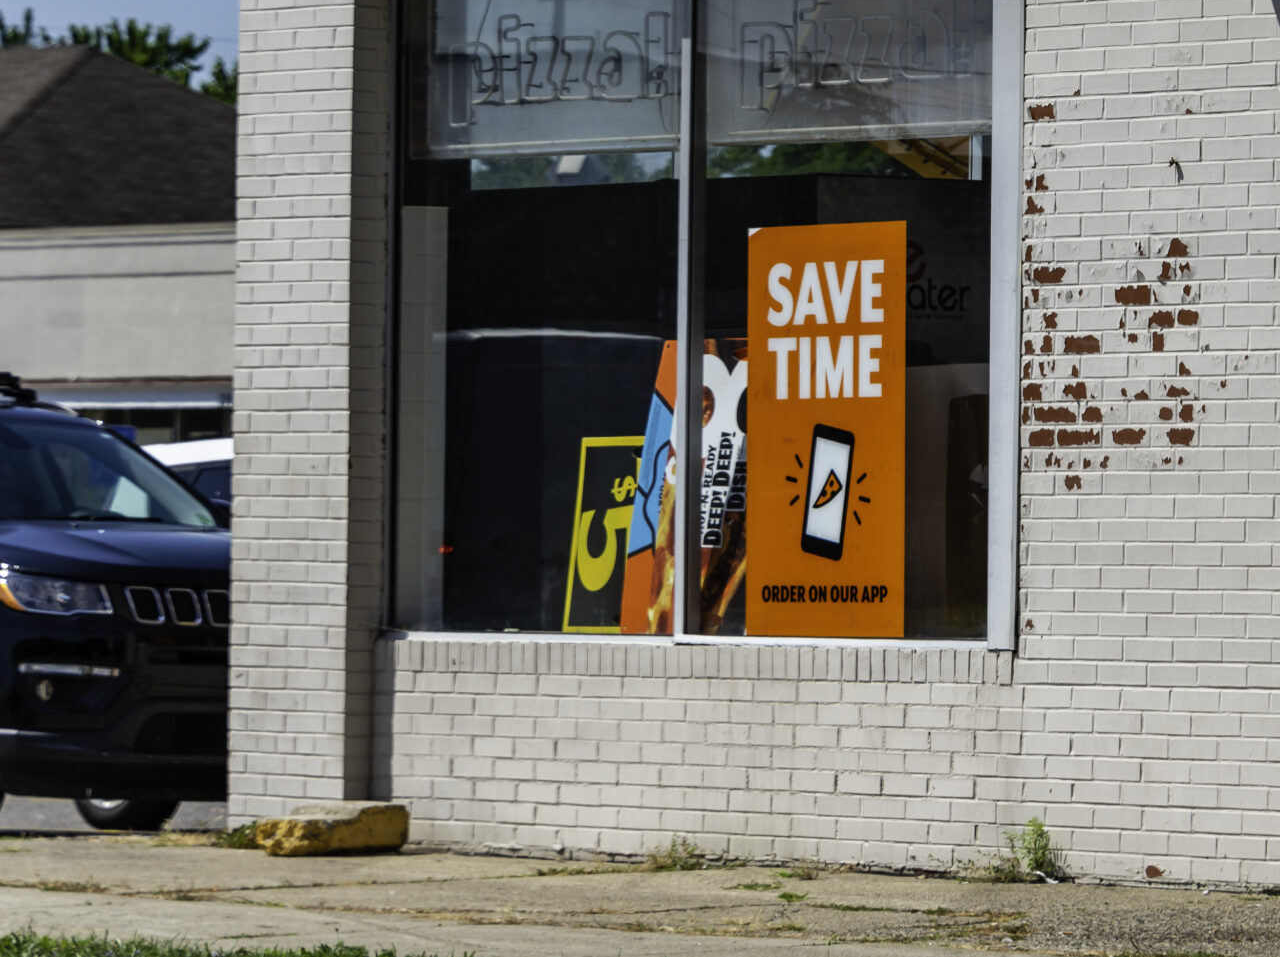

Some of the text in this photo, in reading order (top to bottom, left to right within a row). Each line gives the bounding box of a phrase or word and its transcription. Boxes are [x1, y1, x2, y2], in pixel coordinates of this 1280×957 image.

[767, 258, 885, 328] SAVE
[906, 277, 970, 312] ater
[767, 334, 884, 400] TIME
[702, 431, 736, 546] DEEP! DEEP!
[726, 461, 747, 510] DISH
[762, 585, 888, 603] ORDER ON OUR APP
